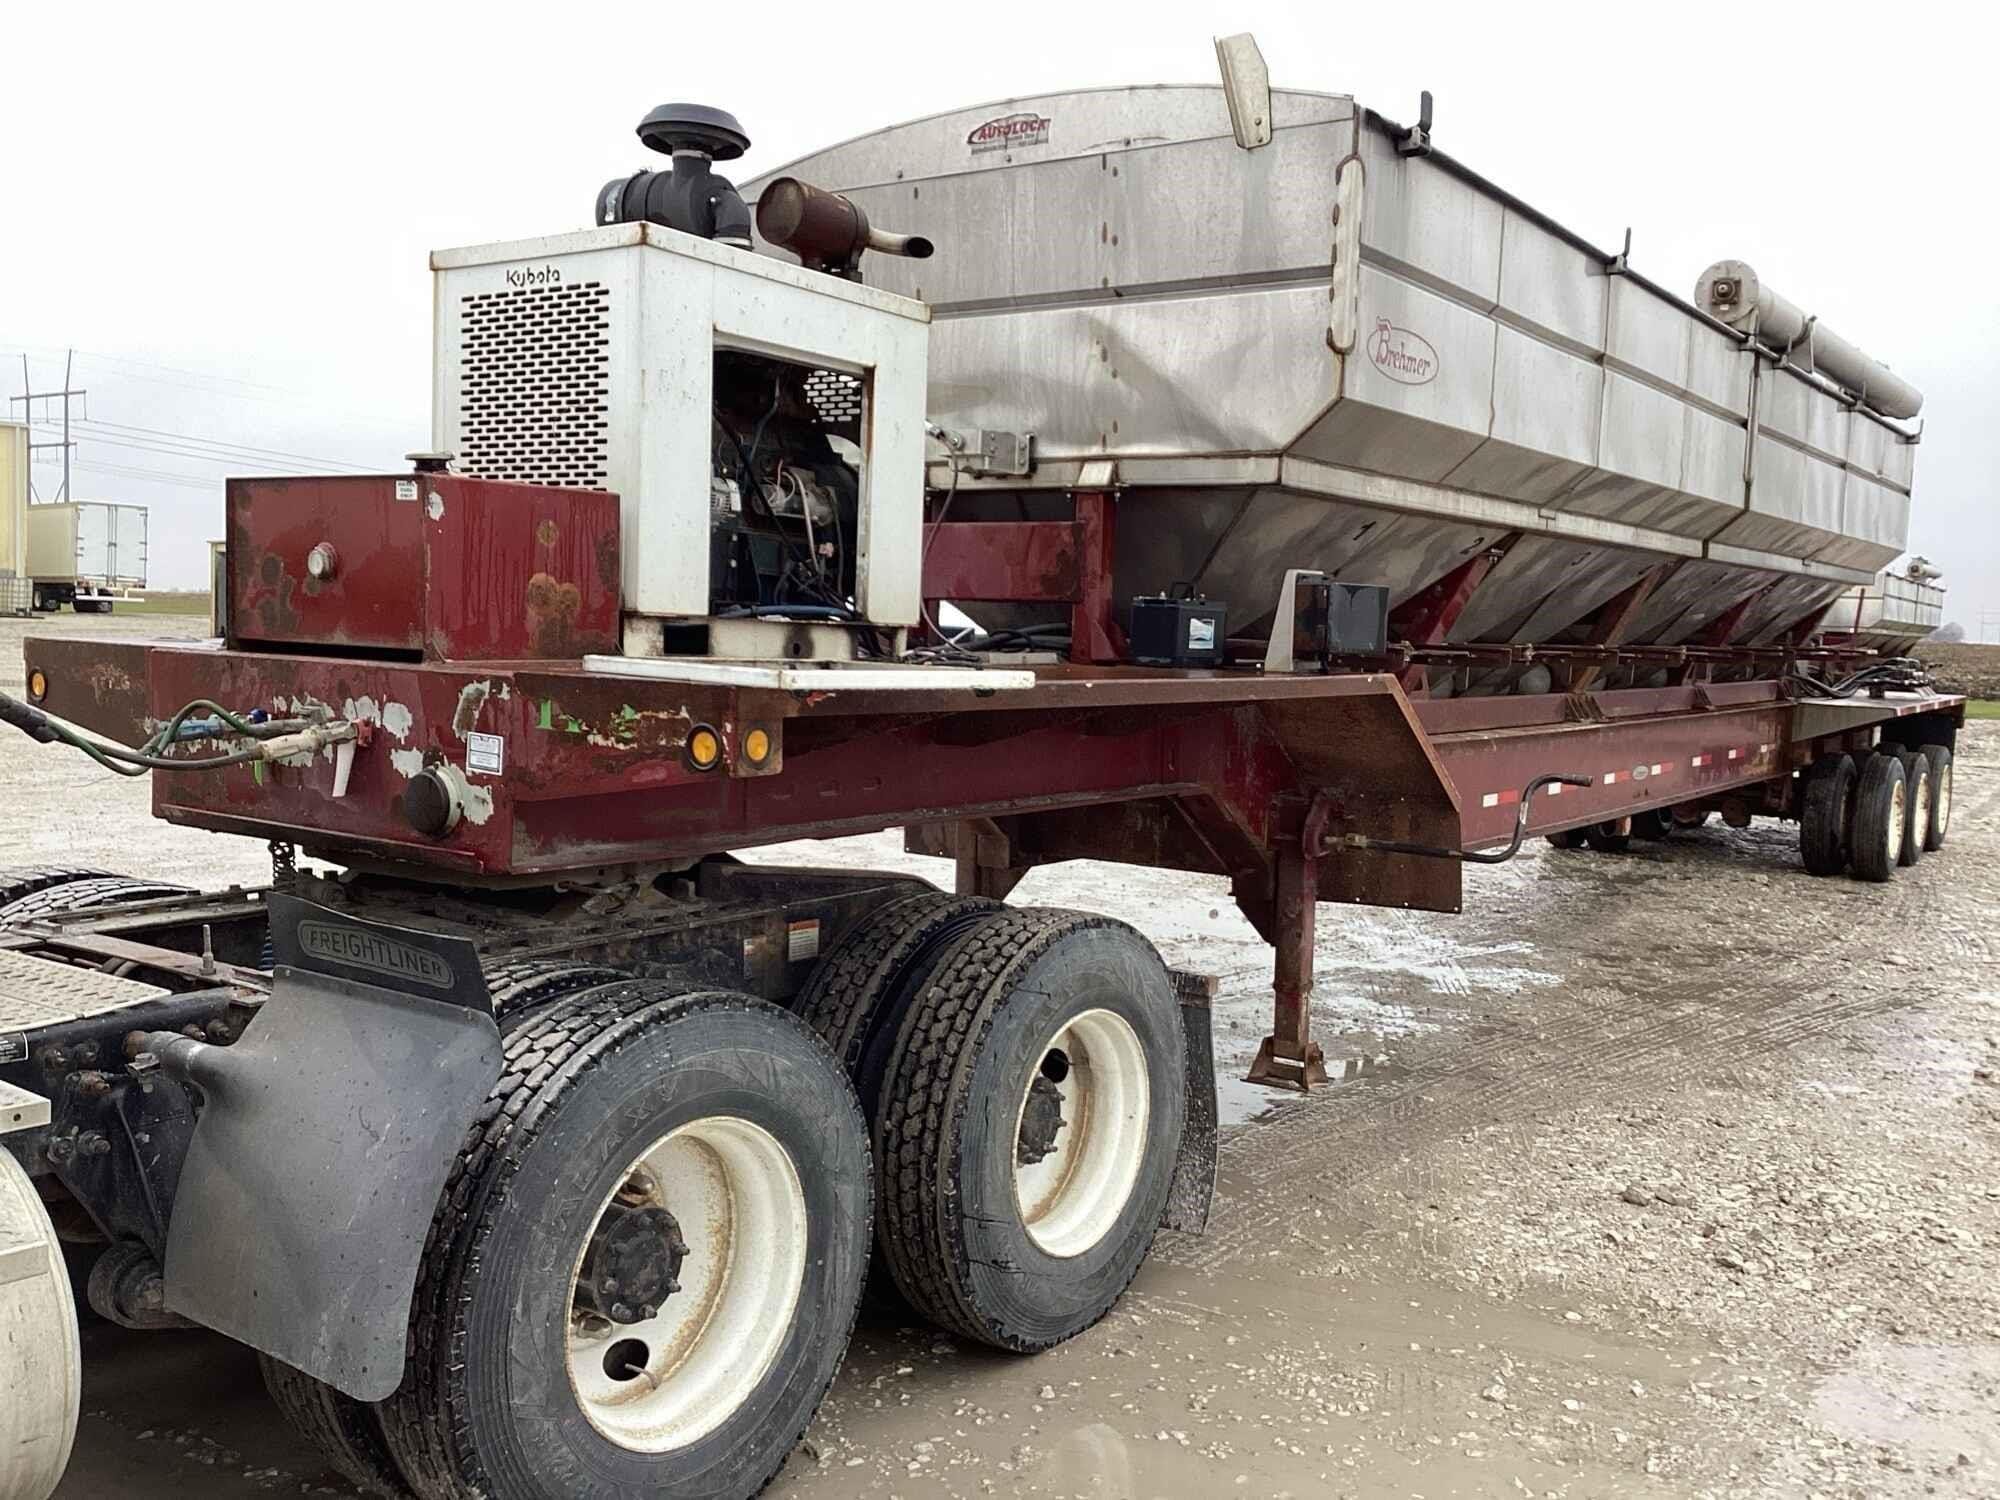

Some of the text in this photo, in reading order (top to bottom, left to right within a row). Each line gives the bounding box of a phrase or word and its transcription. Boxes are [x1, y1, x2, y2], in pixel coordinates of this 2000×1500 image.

[977, 119, 1048, 140] AUTOLOCK
[506, 264, 560, 287] Kubota
[1375, 318, 1430, 377] Brehmer
[1352, 520, 1377, 541] 1
[308, 928, 442, 977] FREIGHTLINER
